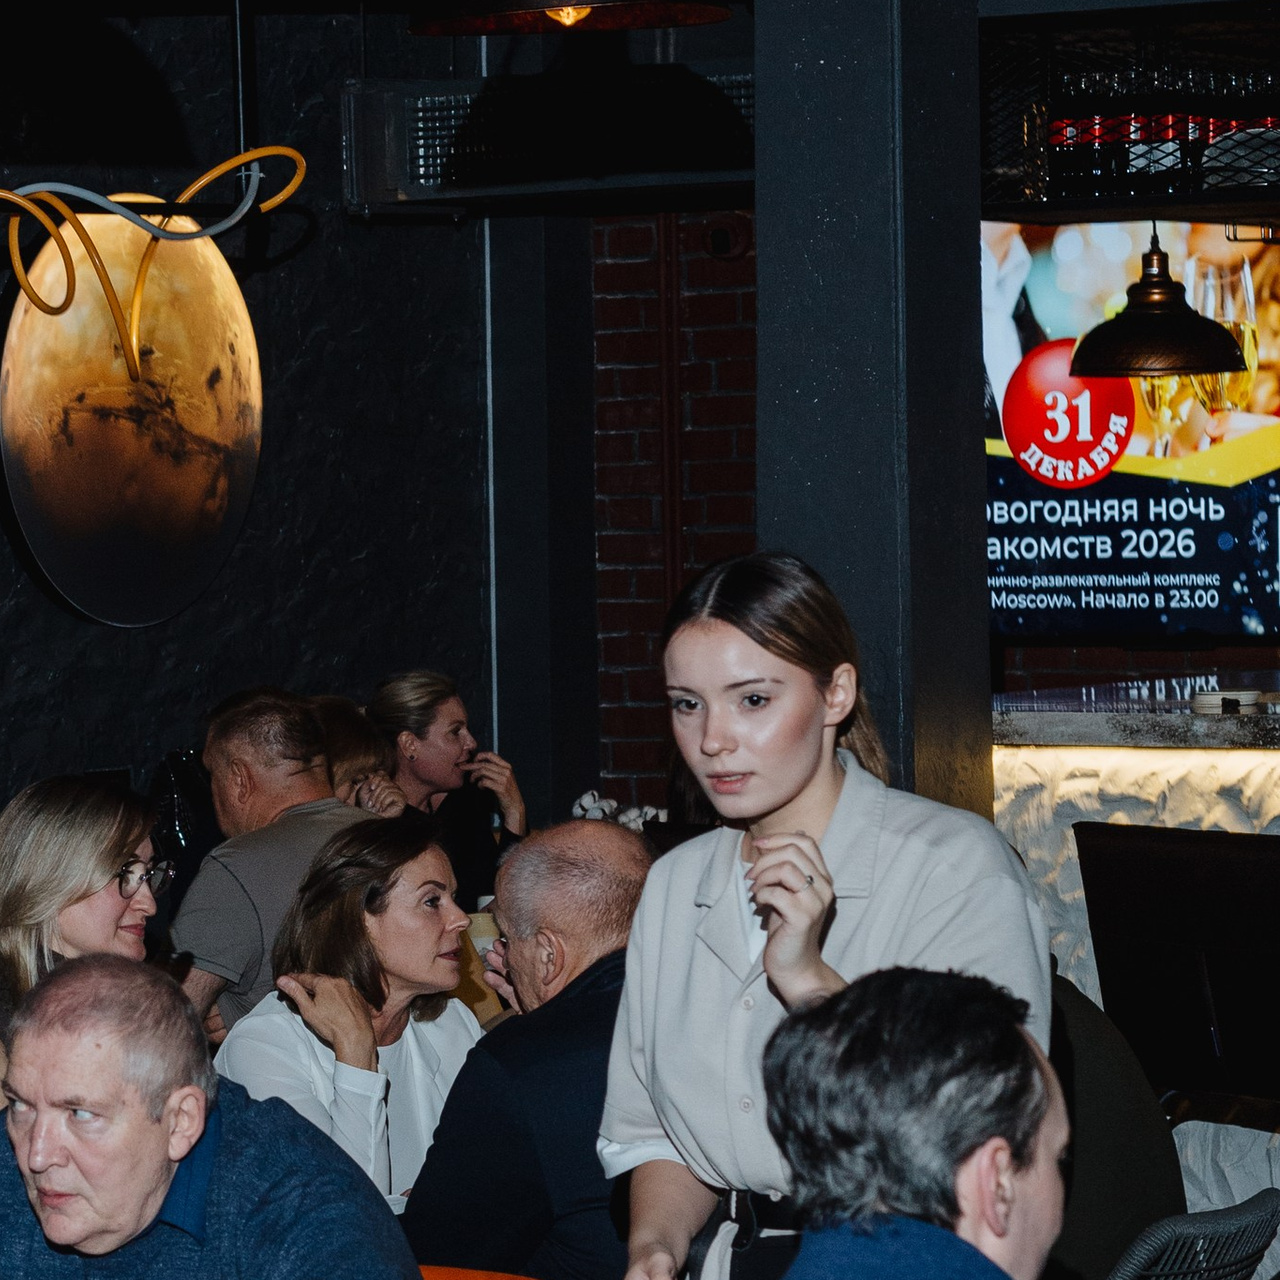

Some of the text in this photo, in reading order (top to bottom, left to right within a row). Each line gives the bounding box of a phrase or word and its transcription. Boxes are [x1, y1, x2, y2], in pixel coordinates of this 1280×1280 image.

[1043, 389, 1094, 444] 31
[1019, 412, 1129, 483] ДЕКАБРЯ
[1120, 527, 1197, 559] 2026
[1153, 573, 1221, 587] комплекс
[1081, 589, 1150, 609] Начало
[1154, 592, 1166, 609] в
[1169, 588, 1220, 609] 23.00
